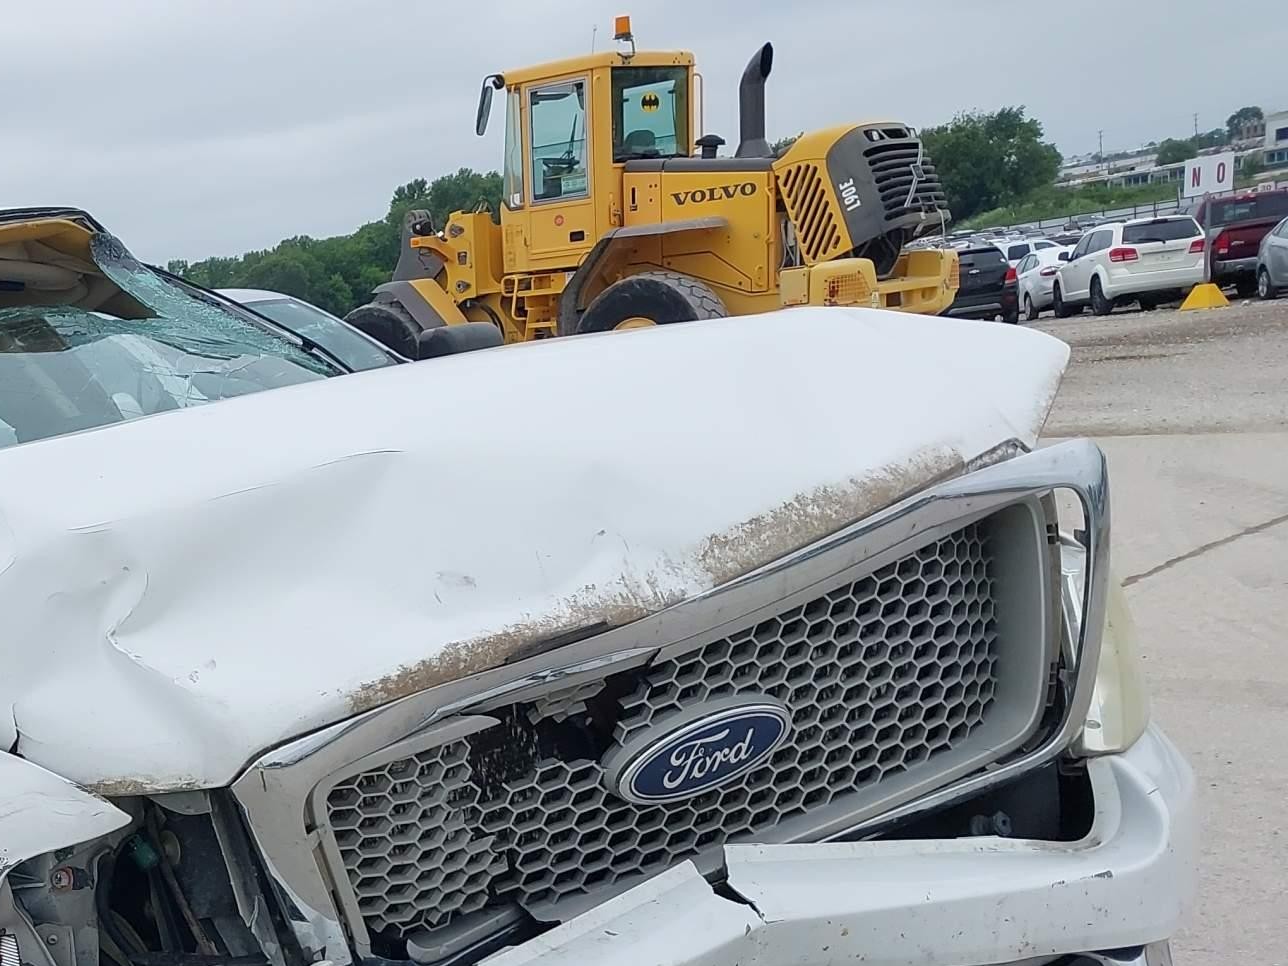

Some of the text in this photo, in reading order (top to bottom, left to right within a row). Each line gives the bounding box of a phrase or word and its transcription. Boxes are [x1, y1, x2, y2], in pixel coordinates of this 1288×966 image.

[1191, 166, 1201, 188] N
[670, 182, 757, 206] VOLVO
[839, 177, 861, 212] L90E
[663, 727, 754, 789] Ford
